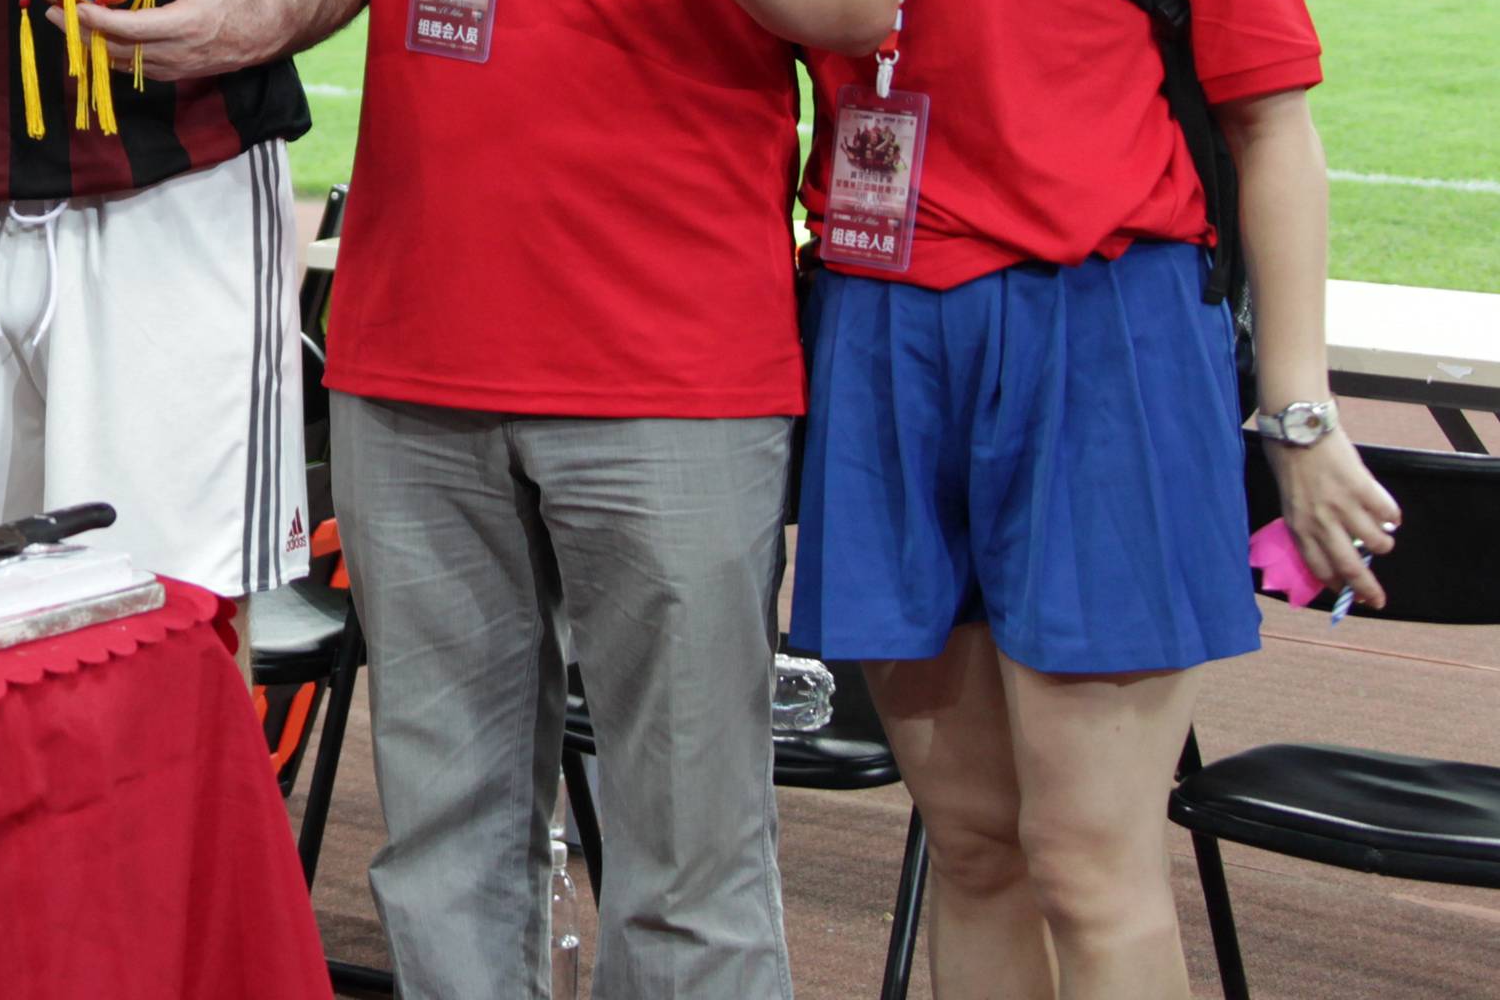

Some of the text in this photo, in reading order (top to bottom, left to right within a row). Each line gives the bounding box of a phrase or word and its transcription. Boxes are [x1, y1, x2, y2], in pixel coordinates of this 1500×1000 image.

[417, 18, 479, 46] 组委会人员
[830, 226, 896, 254] 组委会人员
